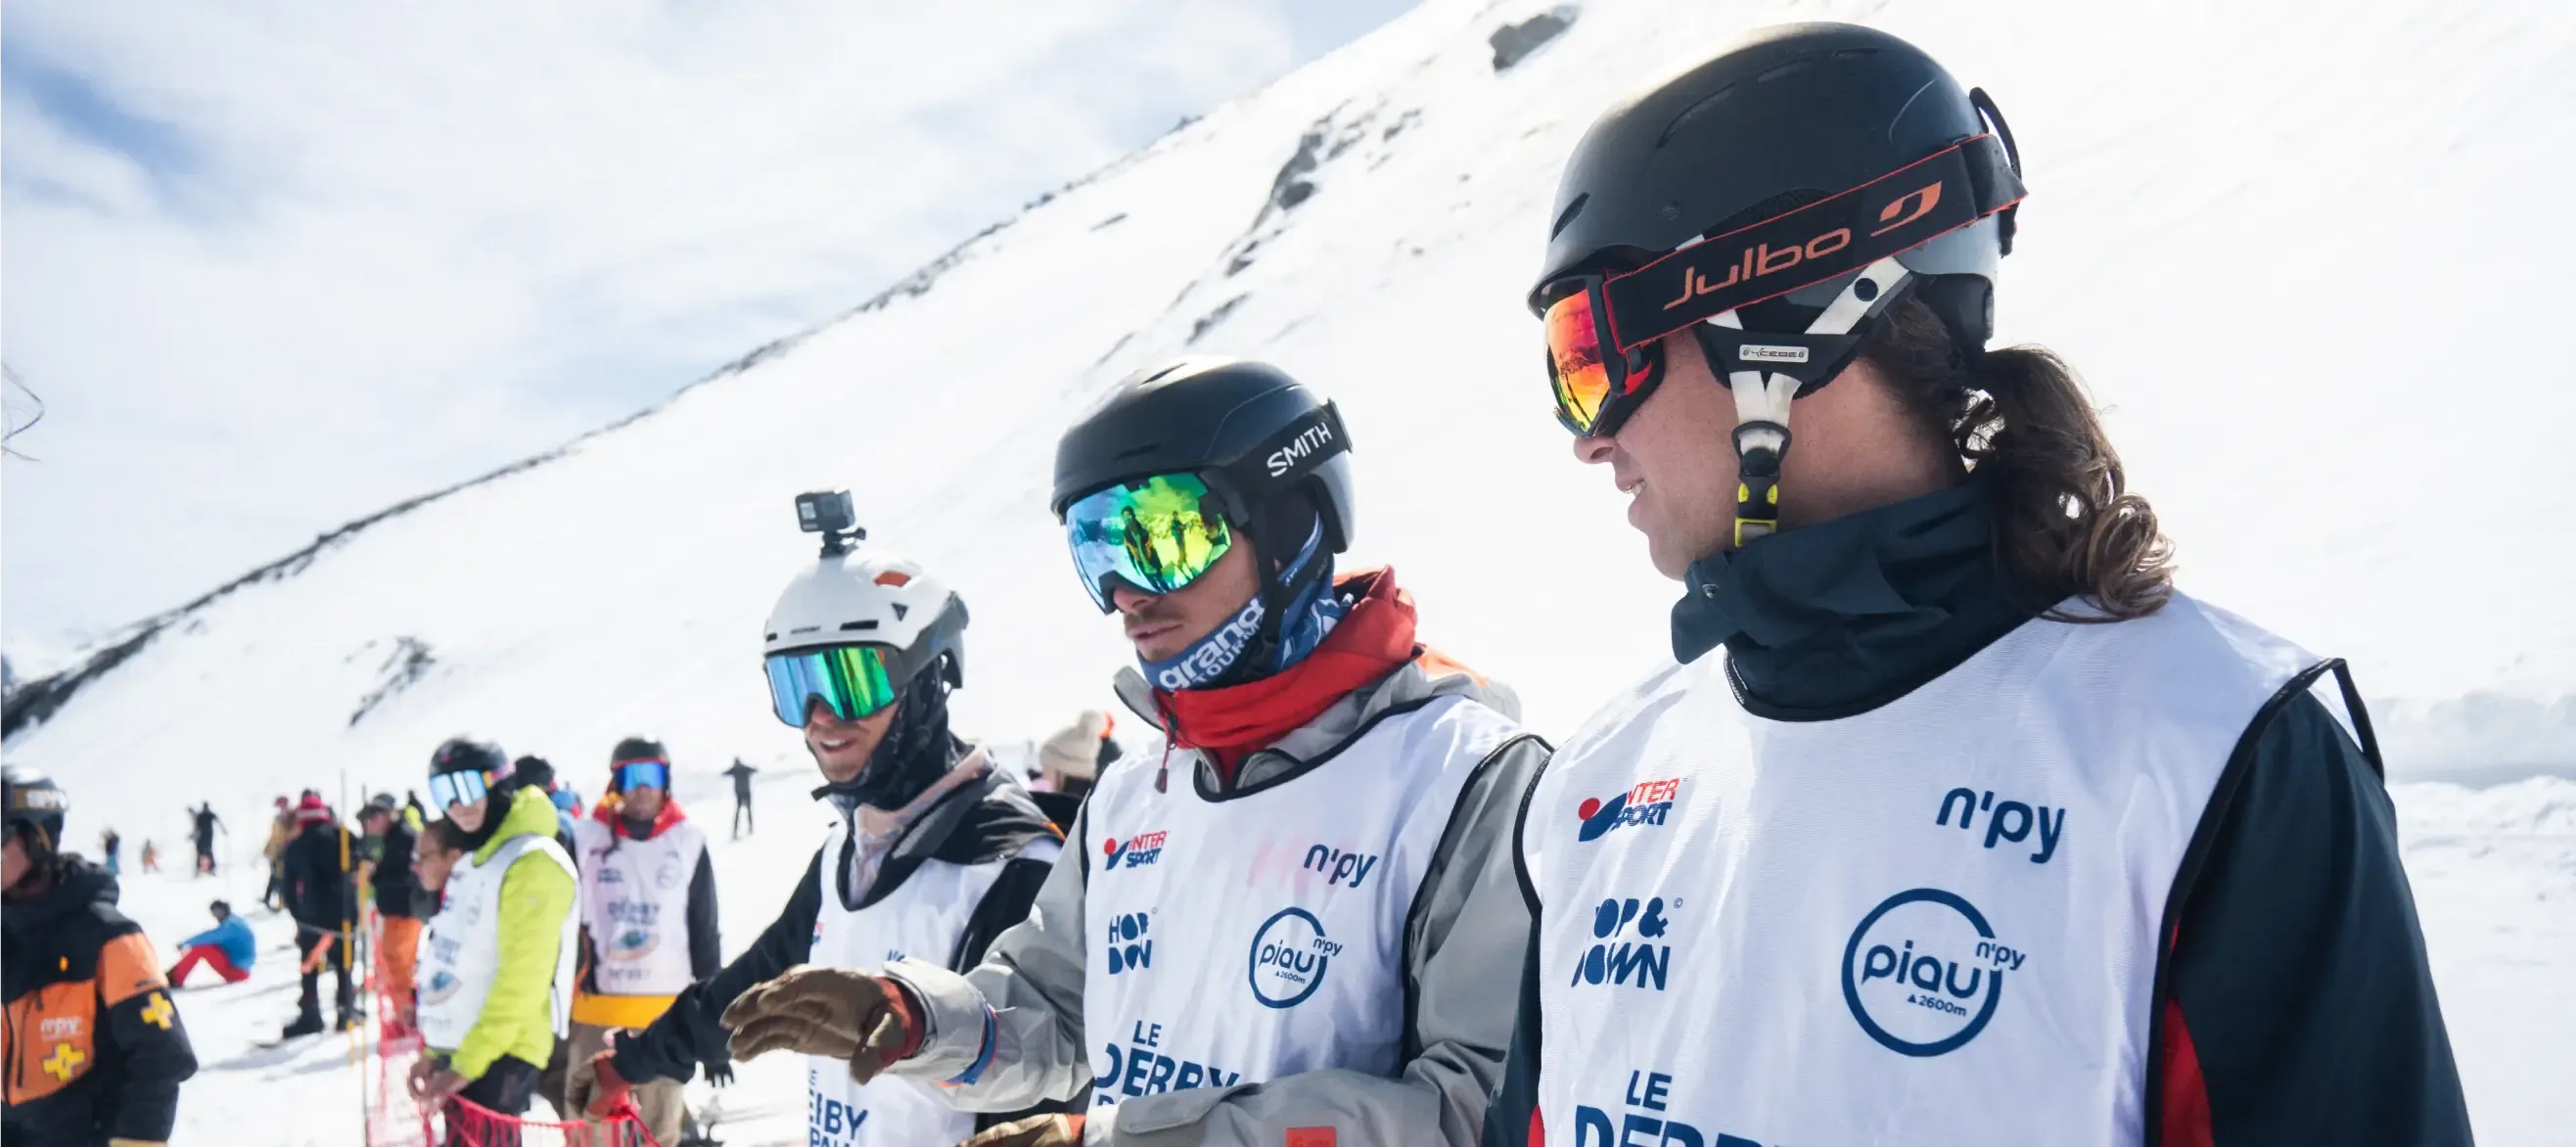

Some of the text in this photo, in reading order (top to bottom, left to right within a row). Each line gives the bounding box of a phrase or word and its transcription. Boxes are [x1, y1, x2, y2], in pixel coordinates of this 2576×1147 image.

[1663, 227, 1851, 310] Julbo
[1266, 421, 1333, 478] SMITH
[1128, 830, 1168, 851] INTER
[1935, 787, 2066, 864] n'py
[1303, 844, 1377, 889] n'py
[1588, 897, 1640, 941] OP
[1258, 940, 1316, 974] piau
[1312, 938, 1344, 957] n'py
[1861, 940, 1983, 999] piau
[1975, 941, 2027, 972] n'py
[1918, 994, 1968, 1018] 2600m
[1132, 1019, 1163, 1047] LE
[1625, 1069, 1673, 1113] LE
